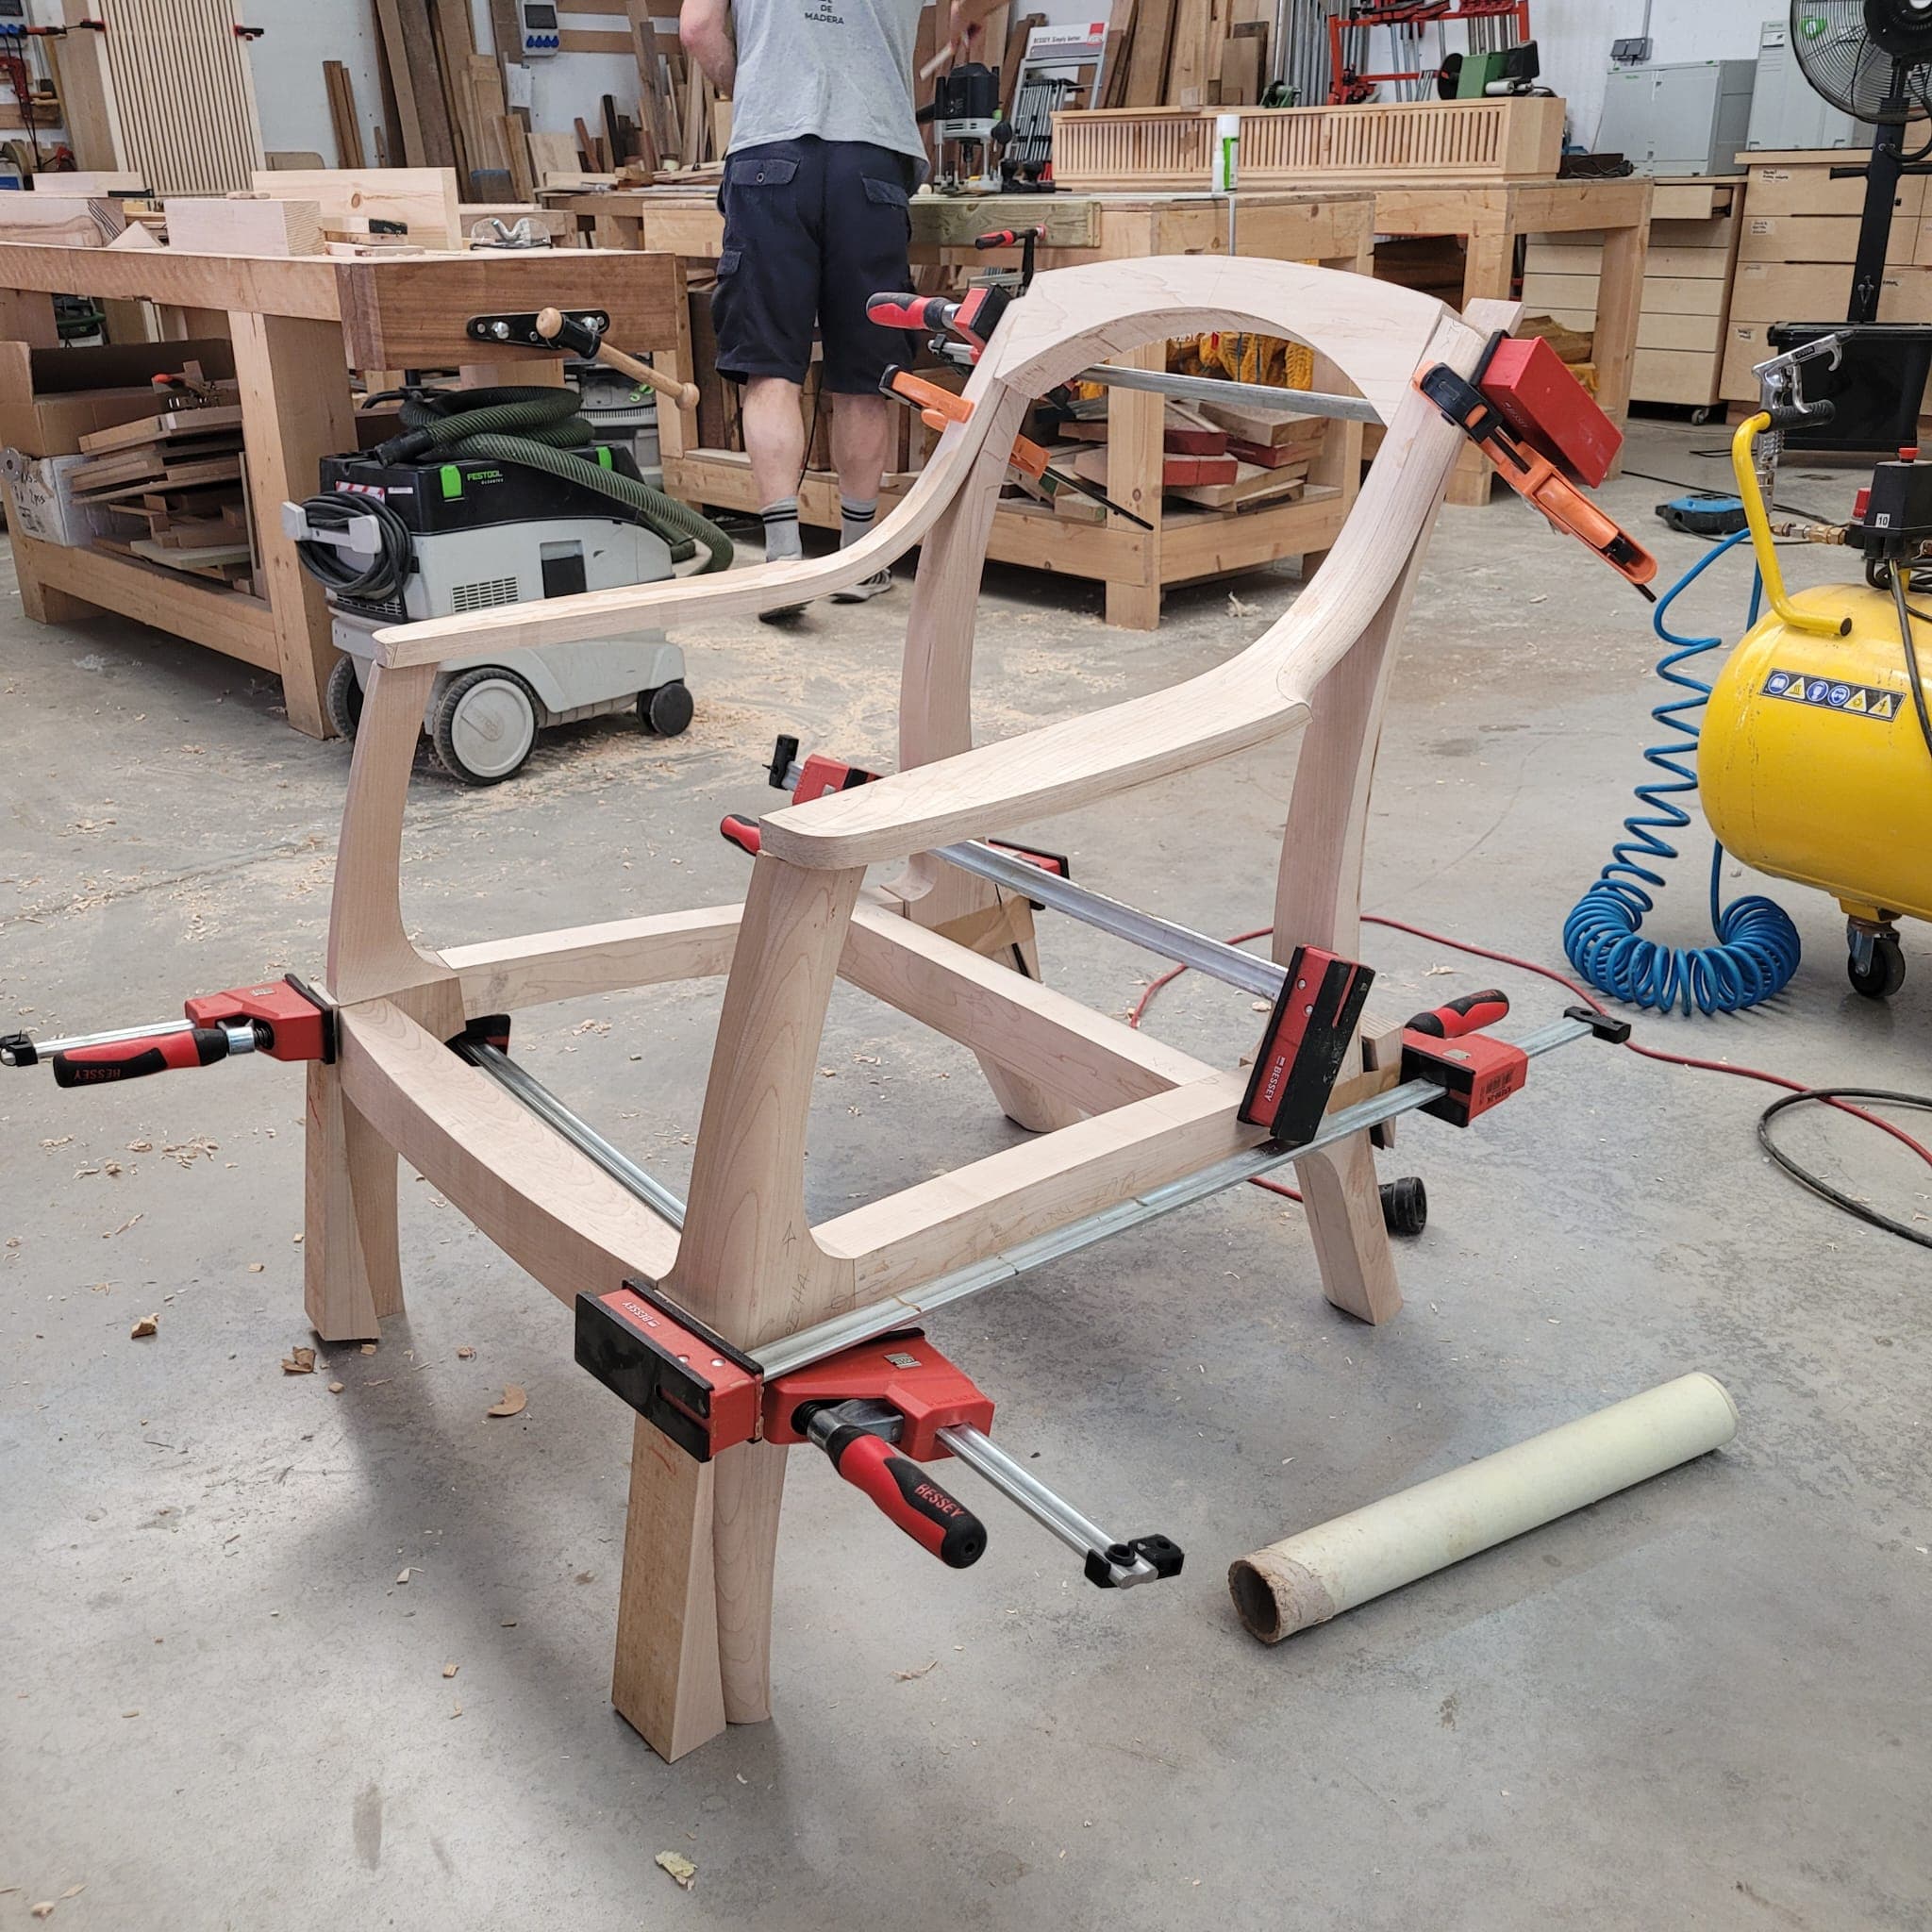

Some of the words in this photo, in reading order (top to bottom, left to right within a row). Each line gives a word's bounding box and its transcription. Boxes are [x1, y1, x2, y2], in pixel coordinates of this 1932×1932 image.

[821, 4, 833, 13] DE
[805, 12, 845, 25] MADERA
[467, 470, 504, 481] FESTOOL
[1878, 515, 1889, 525] 10
[1264, 1065, 1283, 1102] BESSEY
[622, 1302, 654, 1323] BESSEY
[914, 1484, 965, 1517] BESSEY
